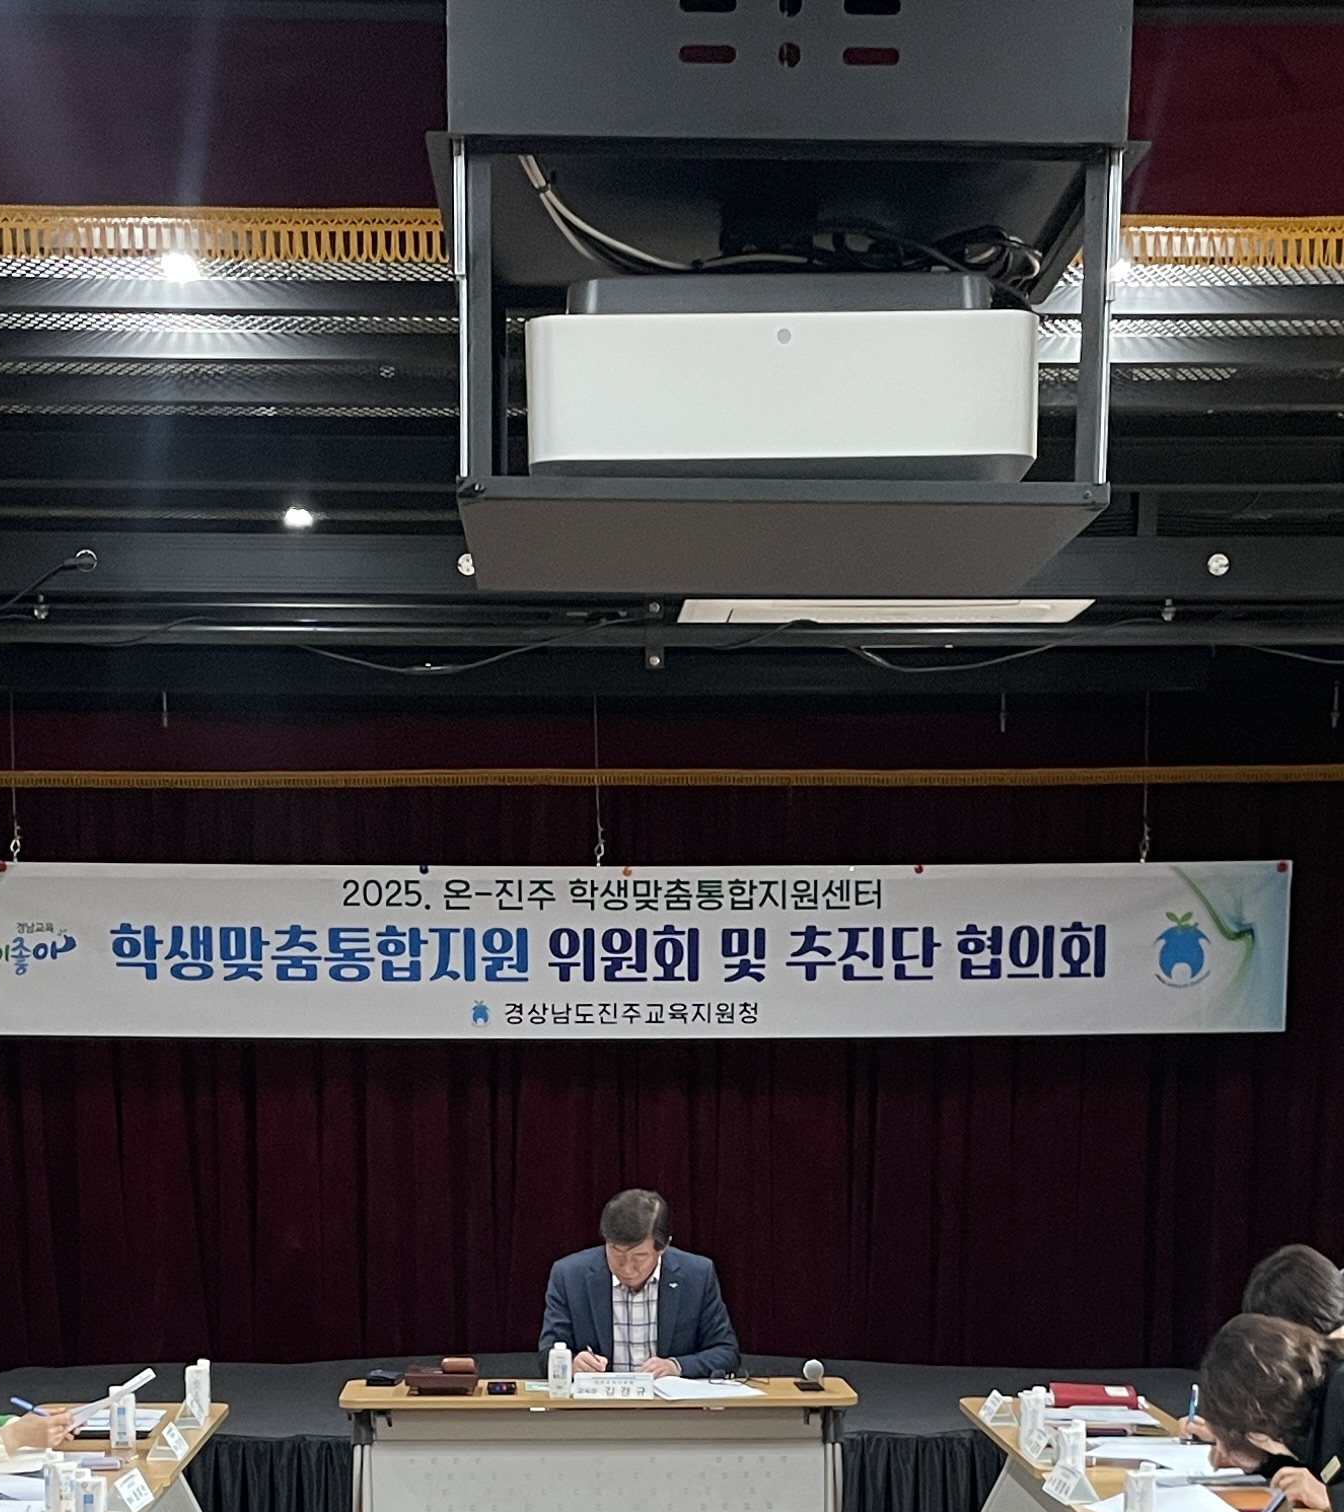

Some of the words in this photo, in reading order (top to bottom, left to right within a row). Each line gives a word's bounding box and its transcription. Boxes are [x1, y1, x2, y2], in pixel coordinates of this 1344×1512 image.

[342, 879, 433, 911] 2025.
[442, 879, 556, 912] 온-진주
[568, 878, 884, 912] 학생맞춤통합지원센터
[109, 923, 530, 983] 학생맞춤통합지원
[547, 924, 700, 983] 위원회
[720, 926, 765, 983] 및
[786, 925, 941, 982] 추진단
[956, 922, 1108, 980] 협의회
[503, 1002, 760, 1027] 경상남도진주교육지원청
